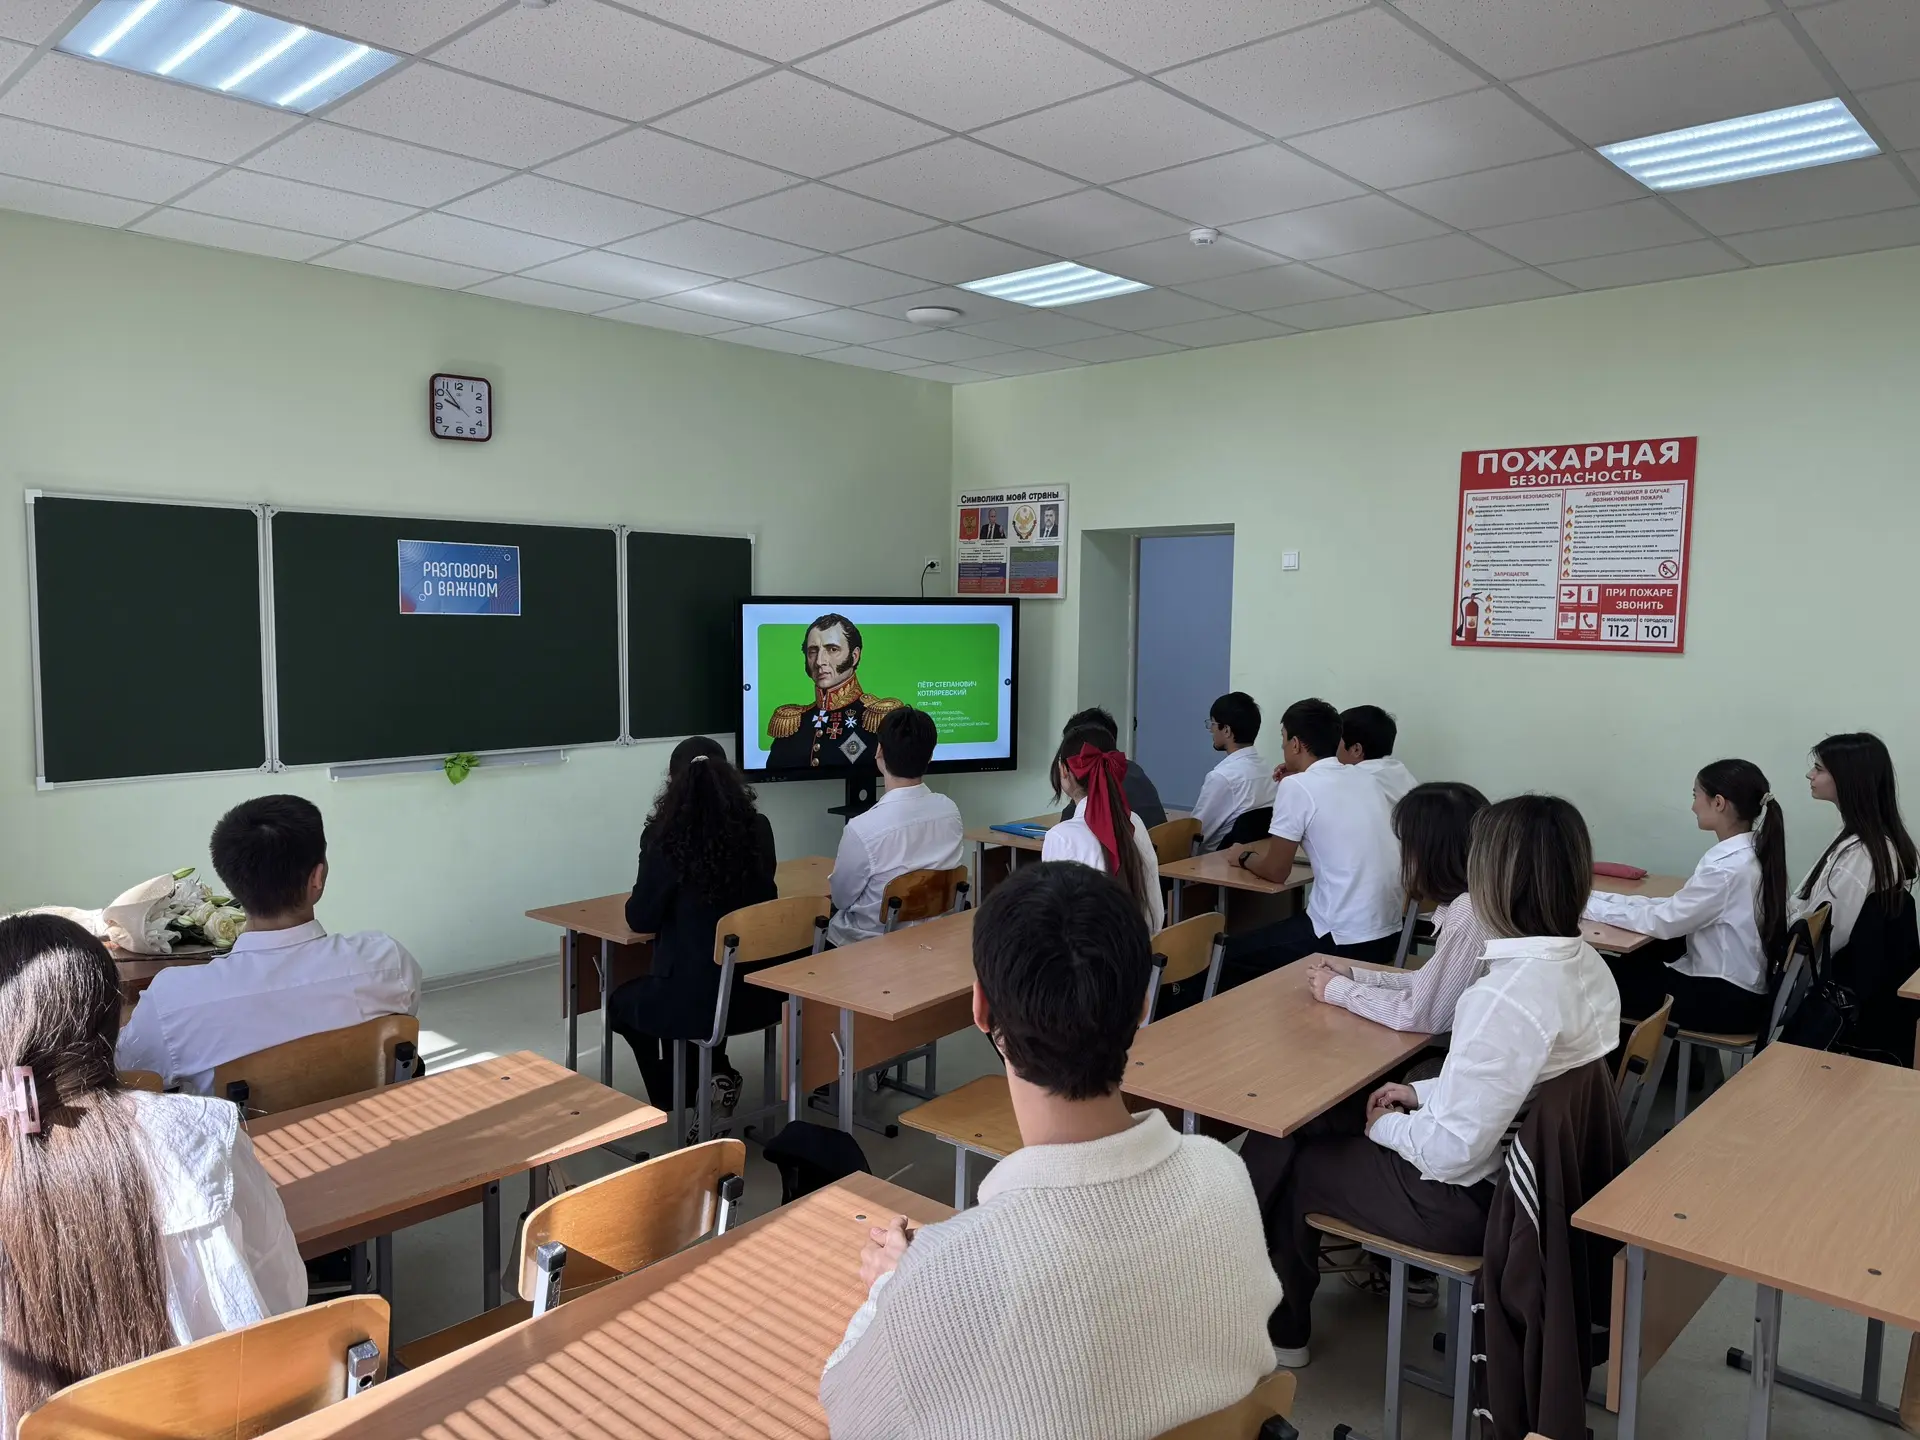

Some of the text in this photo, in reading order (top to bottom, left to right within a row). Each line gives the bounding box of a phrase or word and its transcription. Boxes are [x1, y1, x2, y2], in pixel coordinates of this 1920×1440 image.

[443, 381, 449, 389] 11
[454, 382, 464, 391] 12
[471, 384, 474, 393] 1
[435, 388, 445, 396] 10
[475, 392, 483, 401] 2
[435, 402, 443, 410] 9
[475, 406, 483, 414] 3
[435, 416, 443, 424] 8
[455, 426, 464, 434] 6
[469, 427, 476, 435] 5
[1478, 441, 1680, 475] ПОЖАРНАЯ
[1509, 469, 1643, 487] БЕЗОПАСНОСТЬ
[961, 491, 1059, 504] Символика моей страны
[423, 561, 498, 580] РАЗГОВОРЫ
[423, 580, 498, 598] О ВАЖНОМ
[1605, 588, 1673, 597] ПРИ ПОЖАРЕ
[1615, 600, 1664, 610] ЗВОНИТЬ
[1608, 624, 1629, 638] 112
[1644, 625, 1668, 639] 101
[917, 680, 977, 688] ПЁТР СТЕПАНОВИЧ
[917, 688, 967, 697] КОТЛЯРЕВСКИЙ
